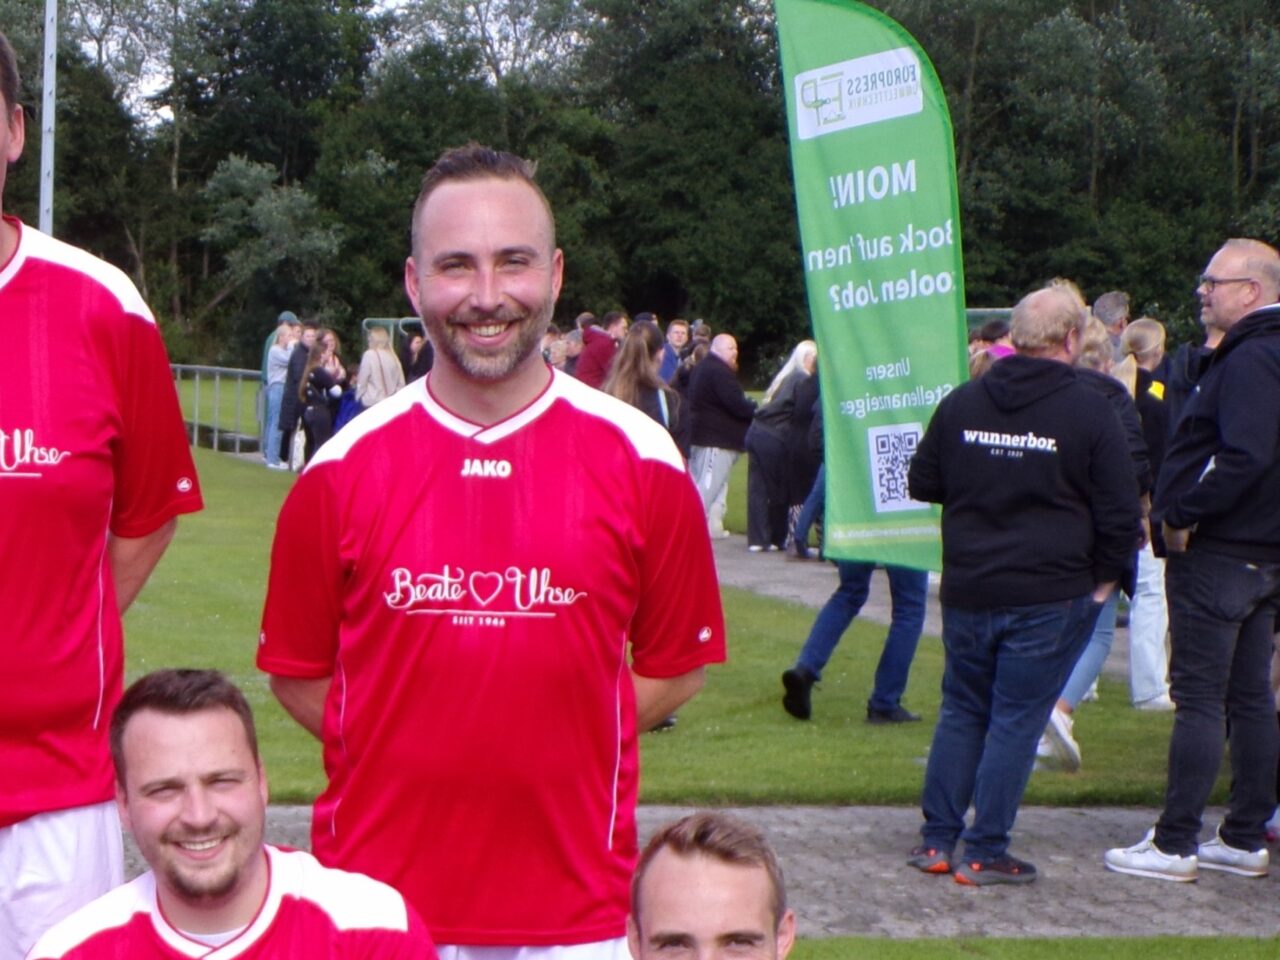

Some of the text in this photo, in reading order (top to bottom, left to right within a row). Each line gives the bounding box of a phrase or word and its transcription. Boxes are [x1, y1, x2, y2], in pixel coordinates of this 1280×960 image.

[963, 429, 1058, 452] wunnerbor.
[461, 458, 512, 478] JAKO
[383, 564, 588, 610] Beate Uhse
[452, 616, 505, 627] SEIT 1946
